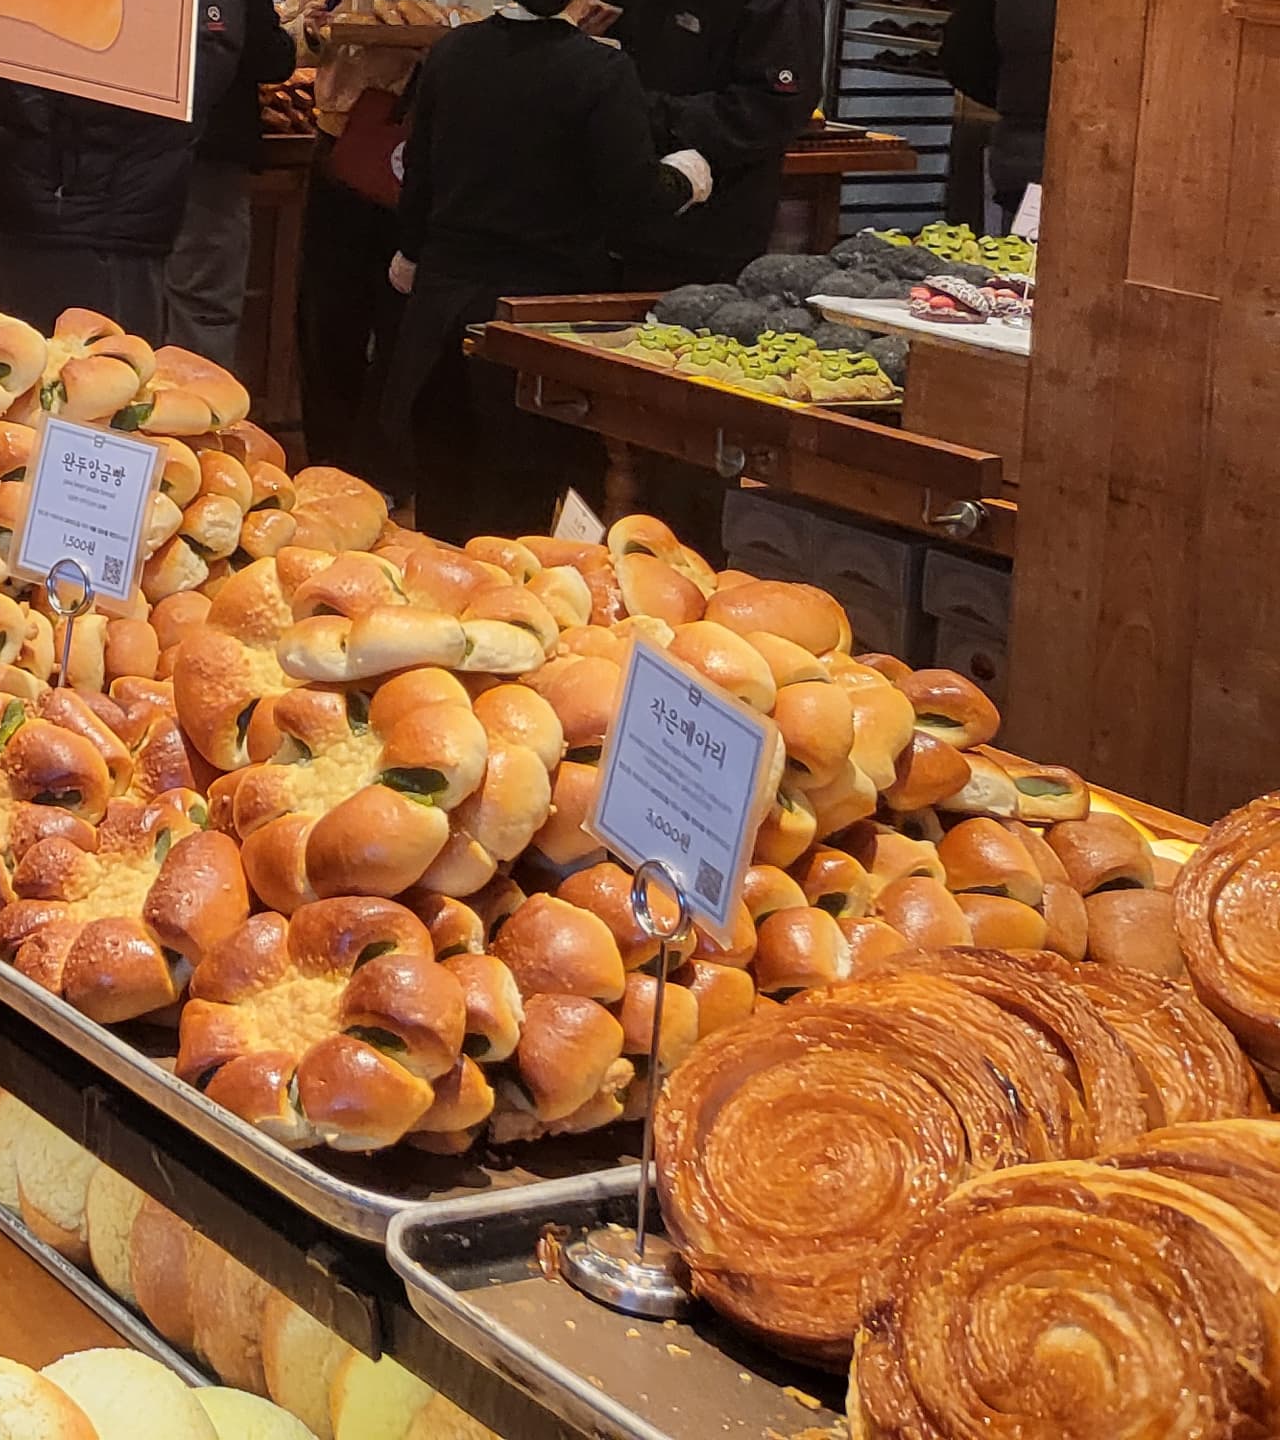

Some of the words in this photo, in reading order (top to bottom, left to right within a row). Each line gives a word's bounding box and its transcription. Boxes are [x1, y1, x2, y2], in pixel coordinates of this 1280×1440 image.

[62, 452, 126, 486] 완두앙금빵
[63, 533, 95, 556] 1,500원
[650, 697, 727, 771] 작은메아리
[645, 808, 691, 853] 3,000원
